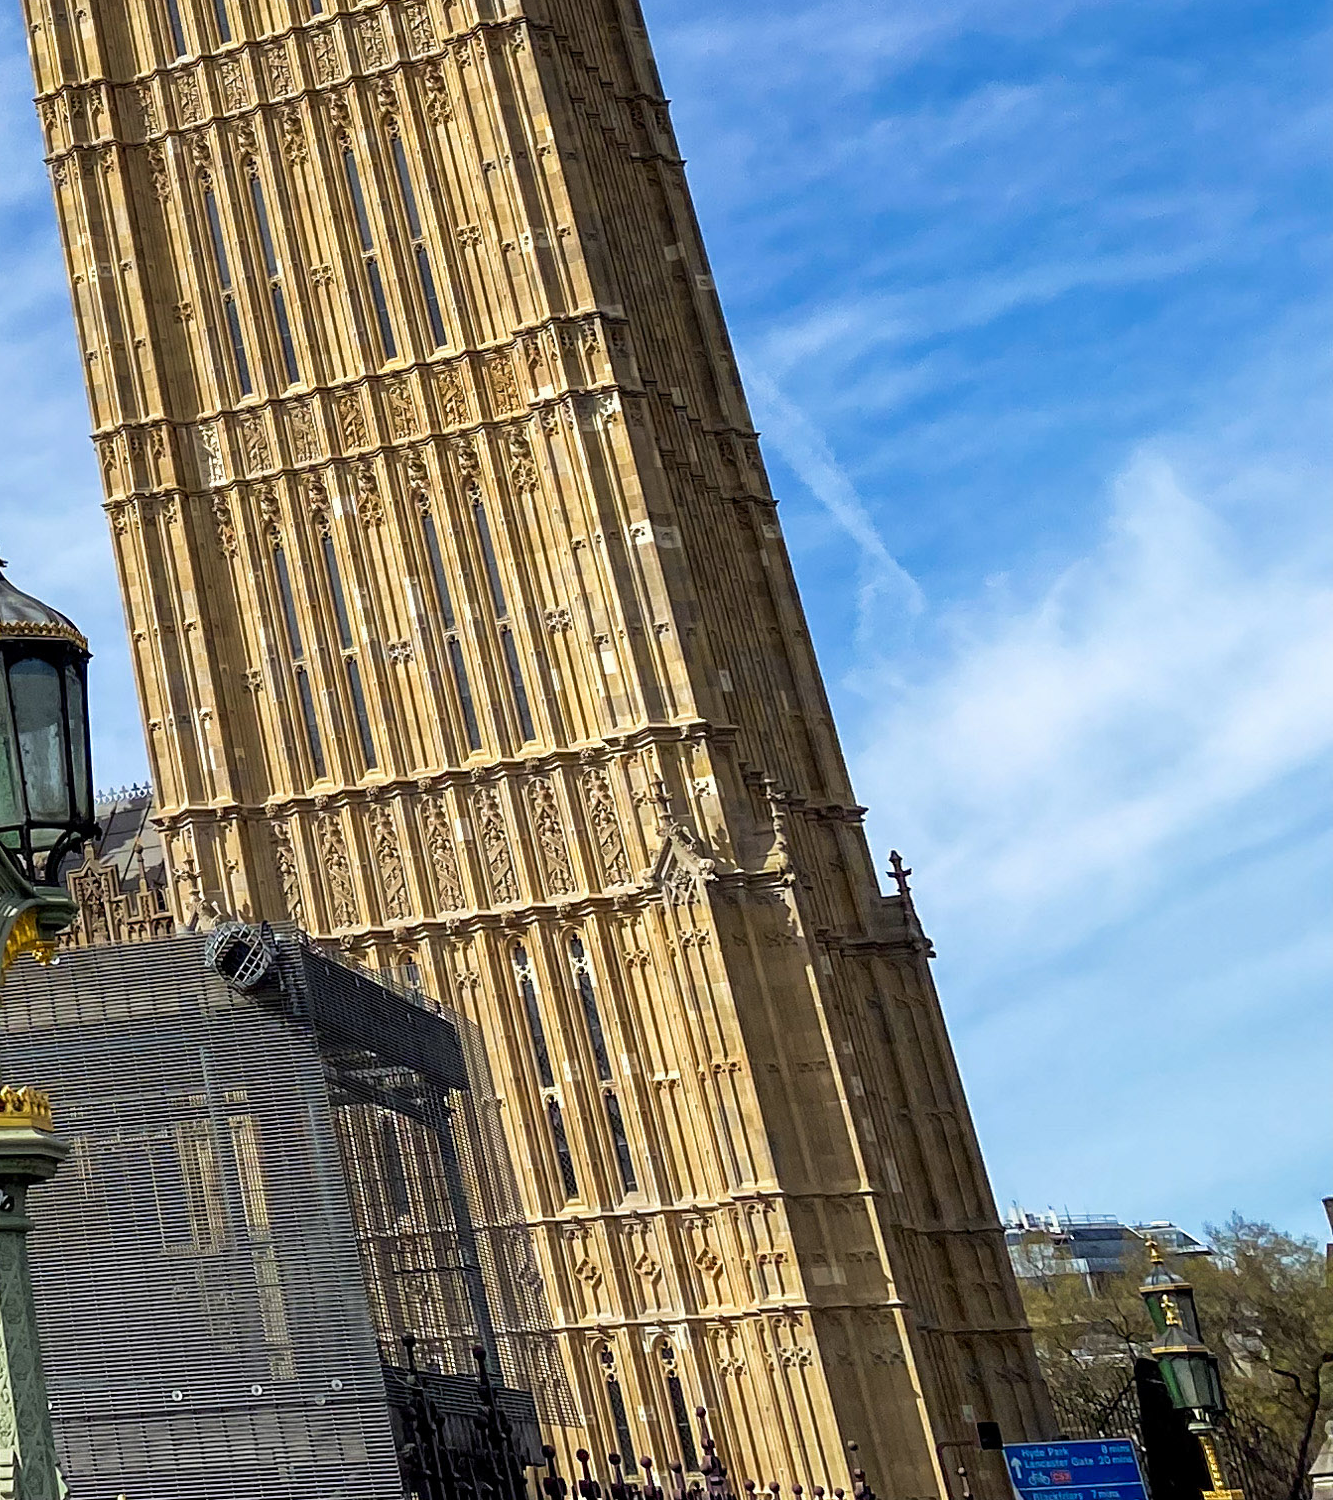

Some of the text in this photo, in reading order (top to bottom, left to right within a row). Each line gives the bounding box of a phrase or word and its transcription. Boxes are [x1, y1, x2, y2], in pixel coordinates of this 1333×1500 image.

[1047, 1446, 1069, 1456] Park
[1109, 1445, 1130, 1453] mins
[1024, 1455, 1134, 1469] Lancaster Gate 20 mins
